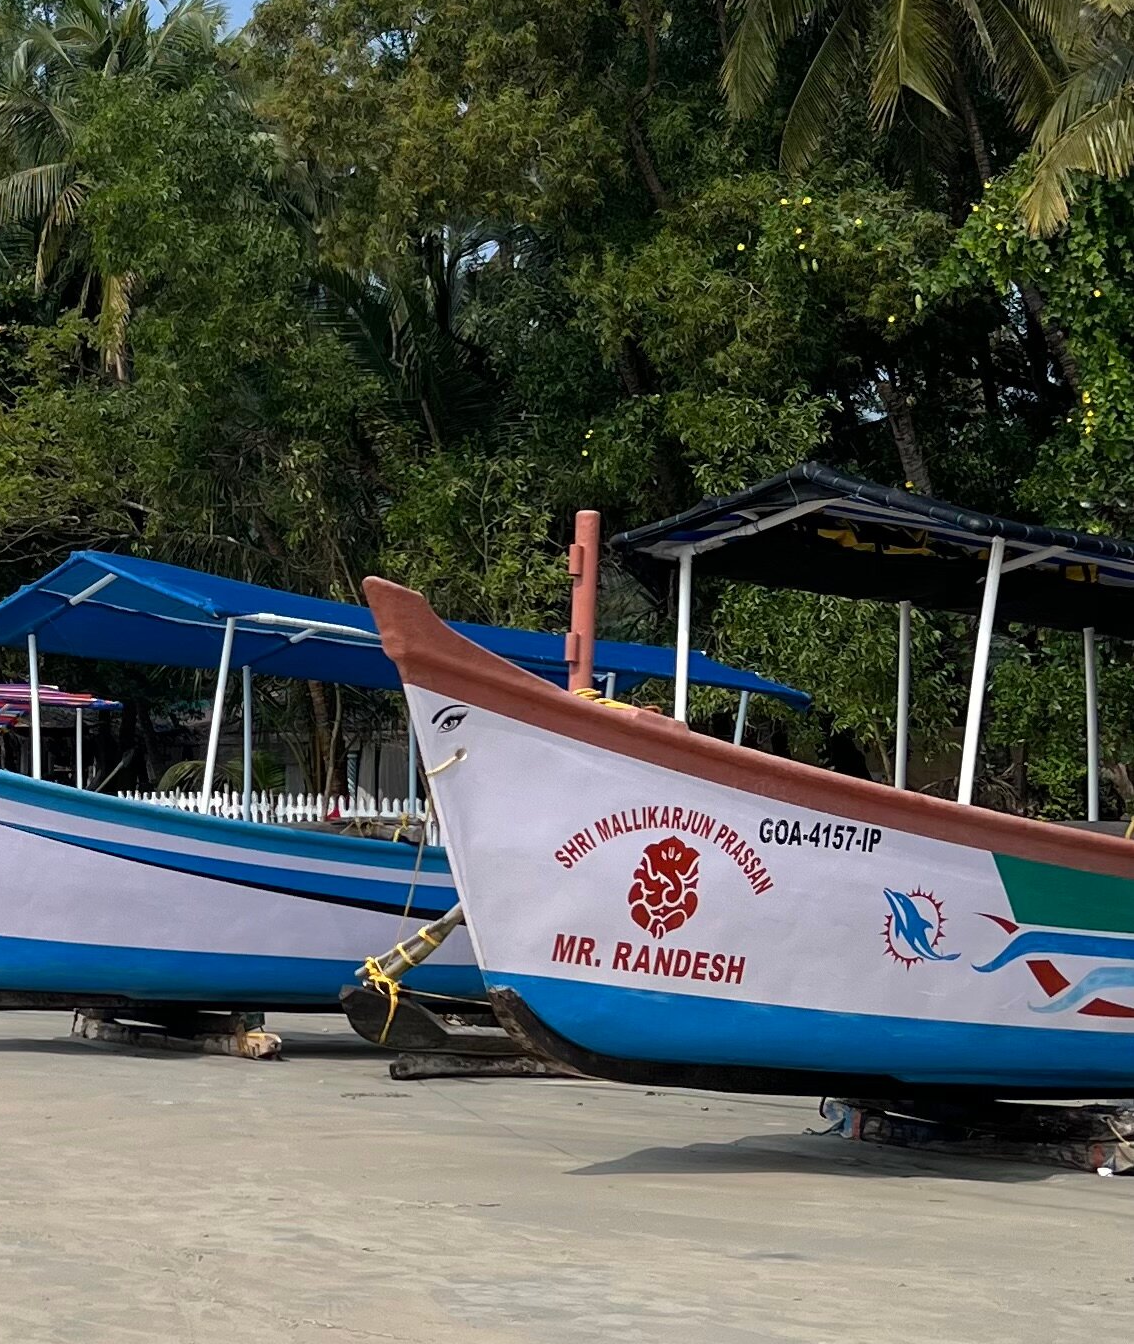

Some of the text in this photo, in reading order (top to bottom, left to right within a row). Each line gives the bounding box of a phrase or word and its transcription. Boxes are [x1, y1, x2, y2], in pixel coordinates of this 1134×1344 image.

[554, 805, 774, 895] SHRI MALLIKARJUN PRASSAN
[759, 817, 882, 853] GOA-4157-IP
[551, 933, 746, 985] MR. RANDESH
